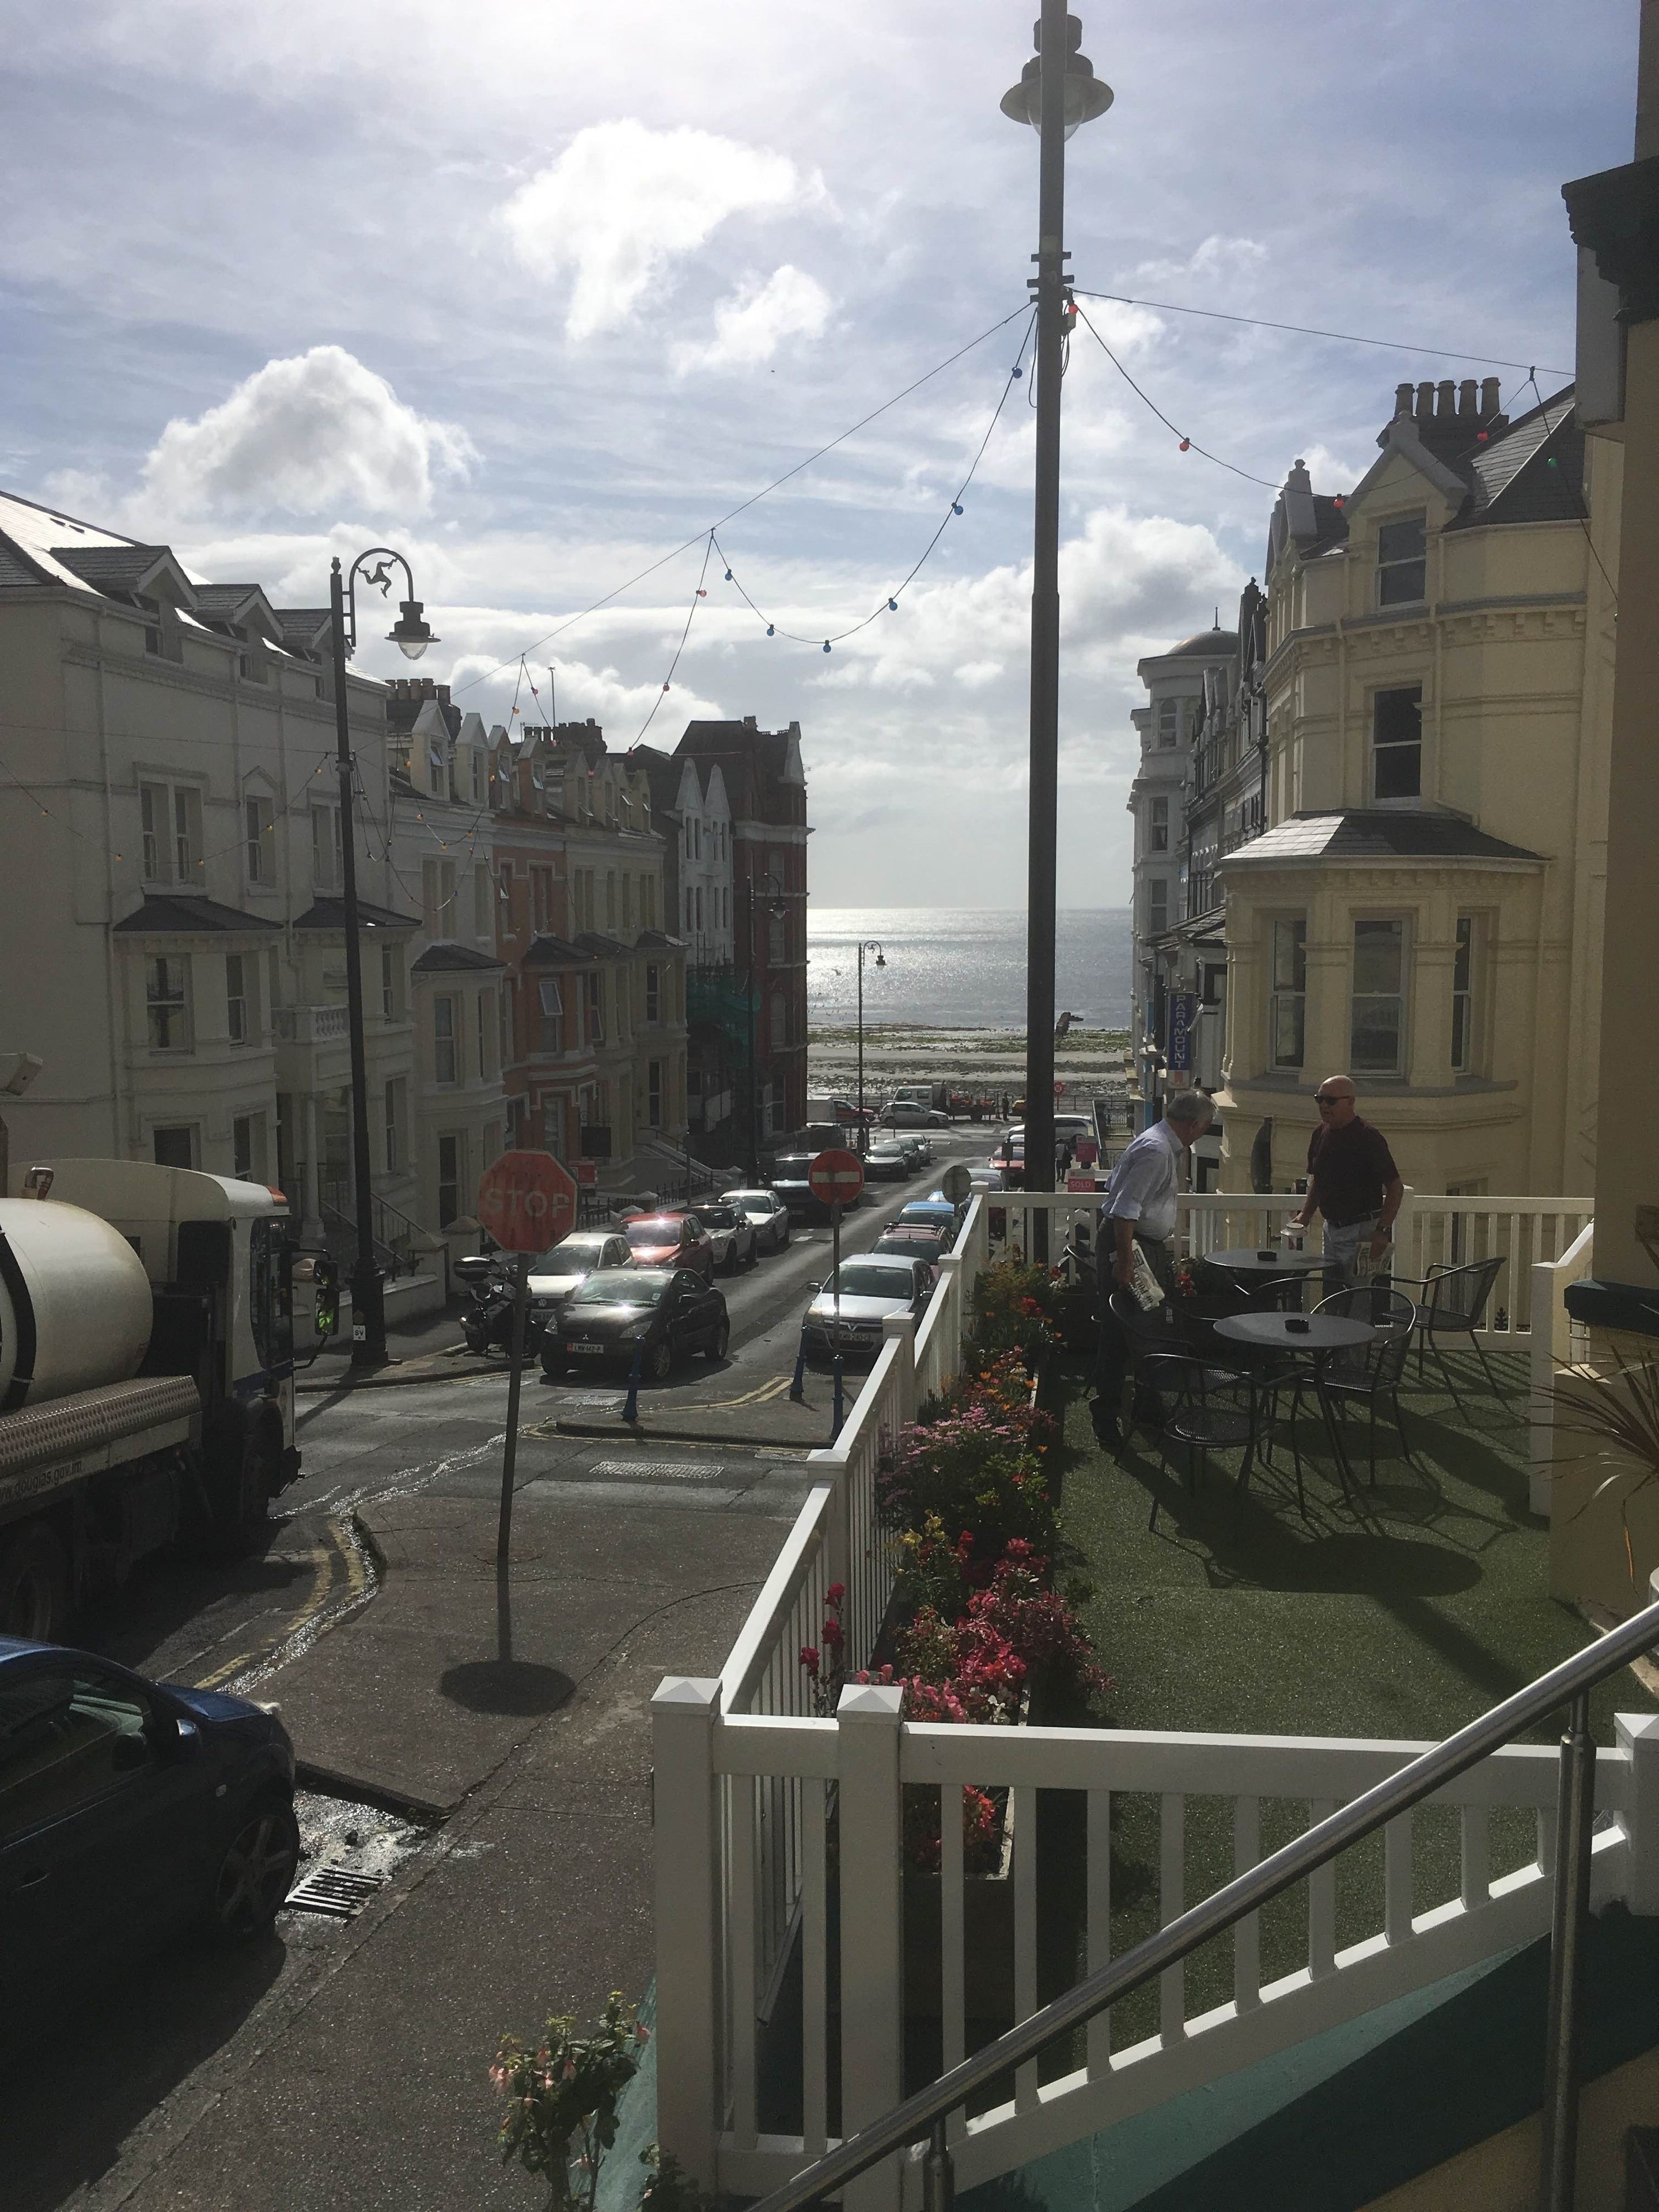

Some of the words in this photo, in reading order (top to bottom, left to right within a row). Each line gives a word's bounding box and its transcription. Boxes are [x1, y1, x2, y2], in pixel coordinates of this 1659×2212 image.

[1173, 995, 1187, 1069] PARAMOUNT
[1070, 1180, 1091, 1188] SOLD
[484, 1188, 570, 1218] STOP
